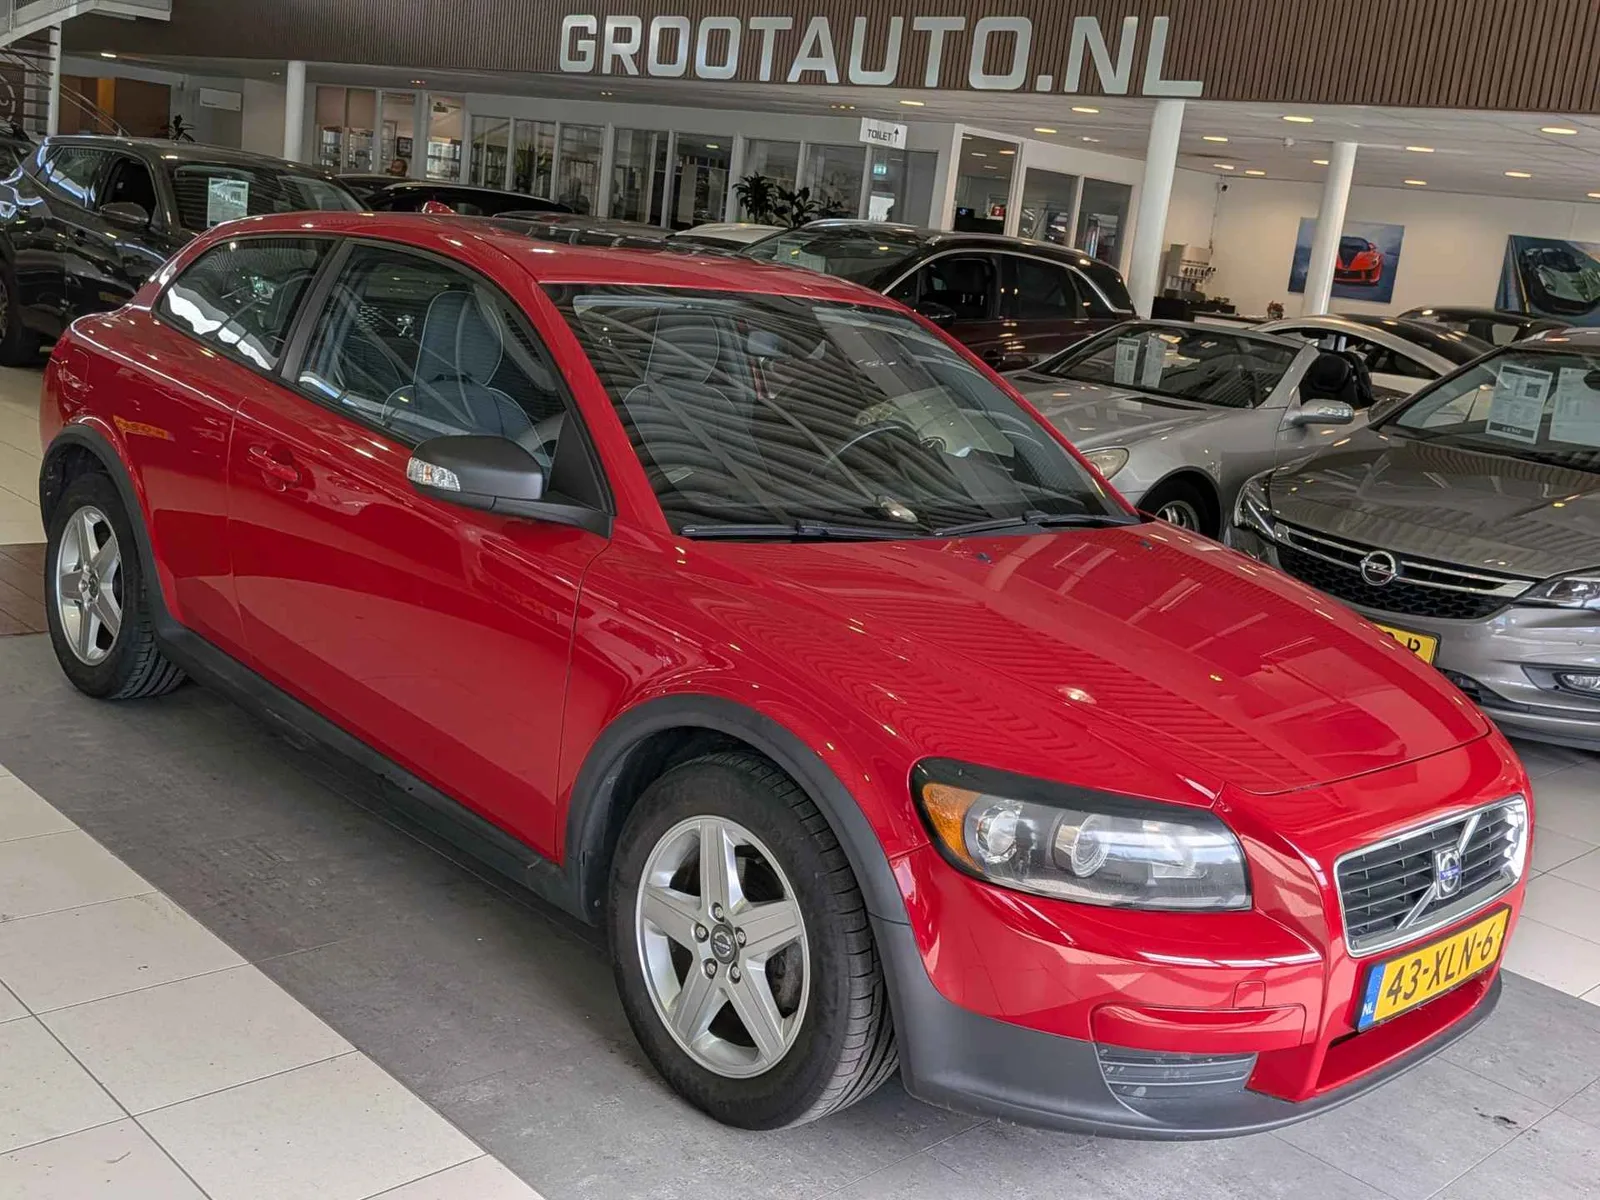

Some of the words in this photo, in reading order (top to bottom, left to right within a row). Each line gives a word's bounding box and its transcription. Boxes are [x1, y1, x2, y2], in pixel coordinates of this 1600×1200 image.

[560, 15, 1203, 96] GROOTAUTO.NL
[867, 128, 892, 141] TOILET
[1386, 922, 1496, 1005] 43-XLN-6
[1362, 1002, 1374, 1016] NL
